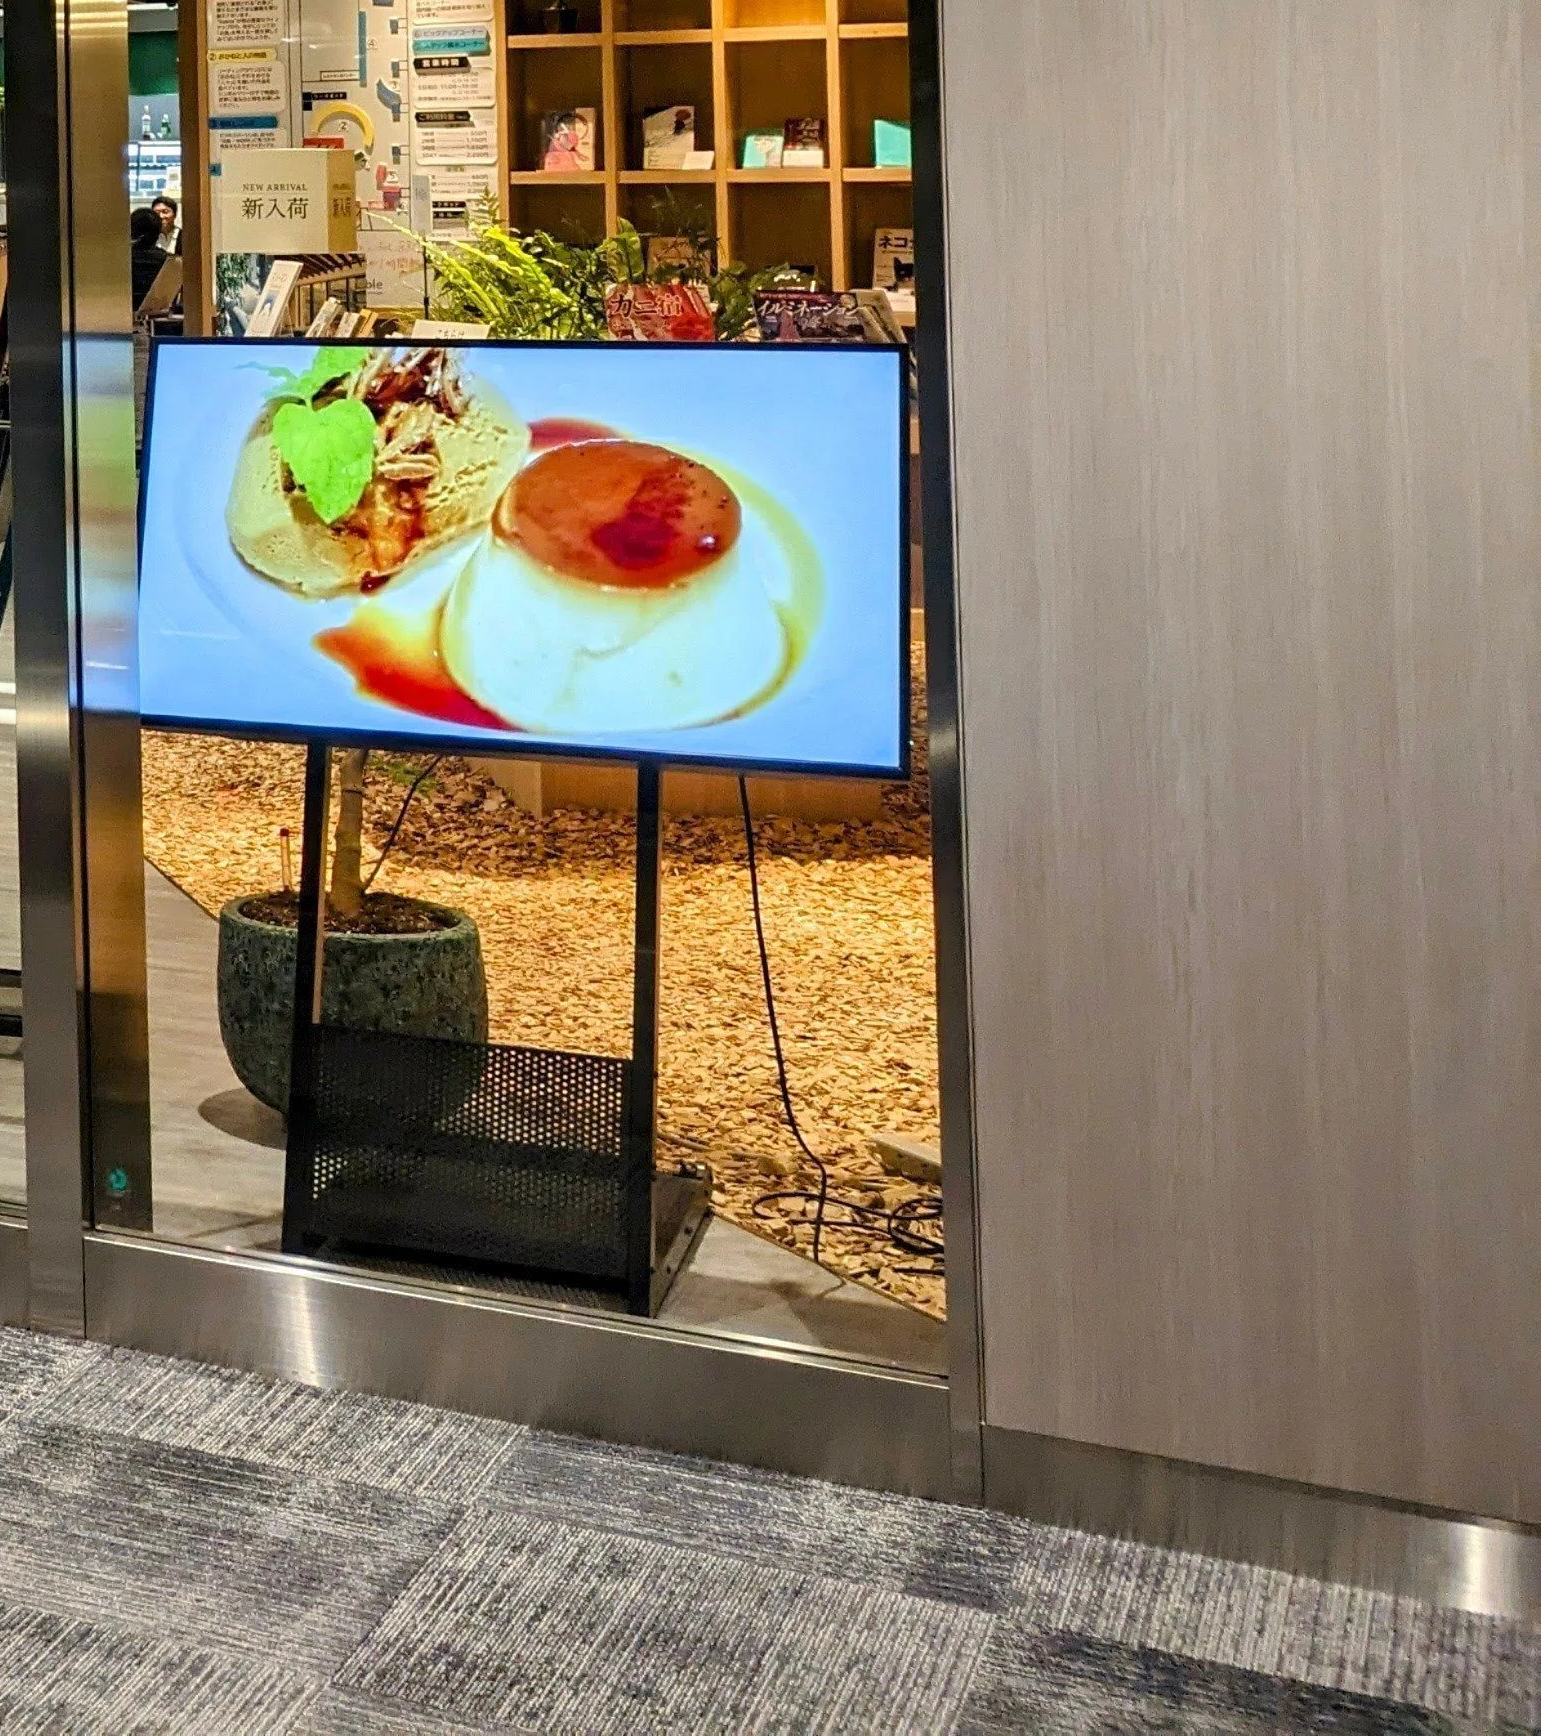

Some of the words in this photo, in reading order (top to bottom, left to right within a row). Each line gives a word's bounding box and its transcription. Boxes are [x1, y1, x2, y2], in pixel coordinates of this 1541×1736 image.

[243, 183, 264, 191] NEW
[267, 183, 308, 191] ARRIVAL
[241, 197, 309, 220] 新入荷
[878, 235, 914, 249] ネコ
